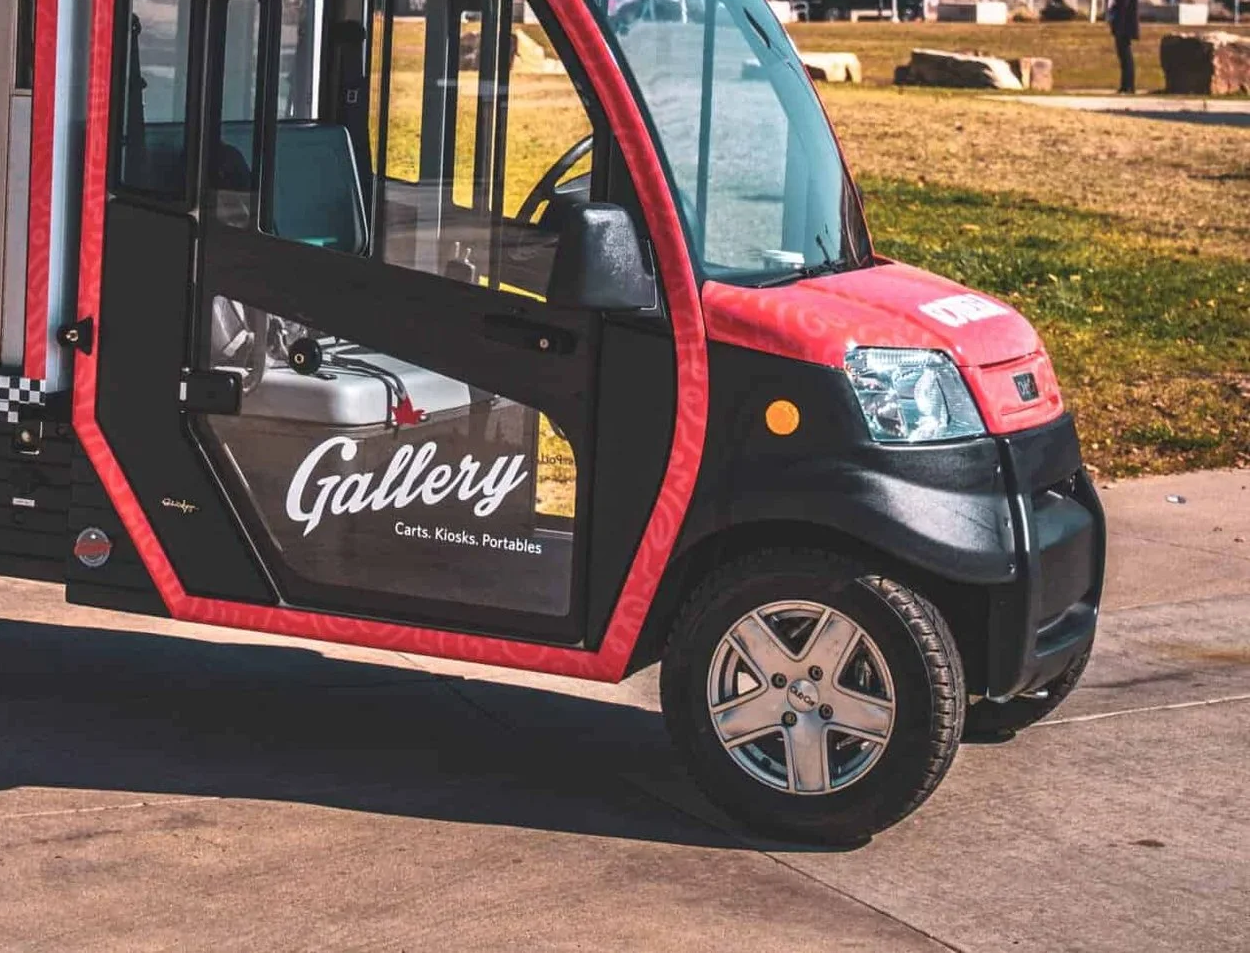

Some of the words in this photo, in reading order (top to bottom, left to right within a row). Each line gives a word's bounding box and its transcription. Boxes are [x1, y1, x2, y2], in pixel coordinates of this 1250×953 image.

[285, 436, 528, 537] Gallery
[395, 522, 431, 539] Carts.
[435, 527, 479, 546] Kiosks.
[482, 534, 542, 554] Portables
